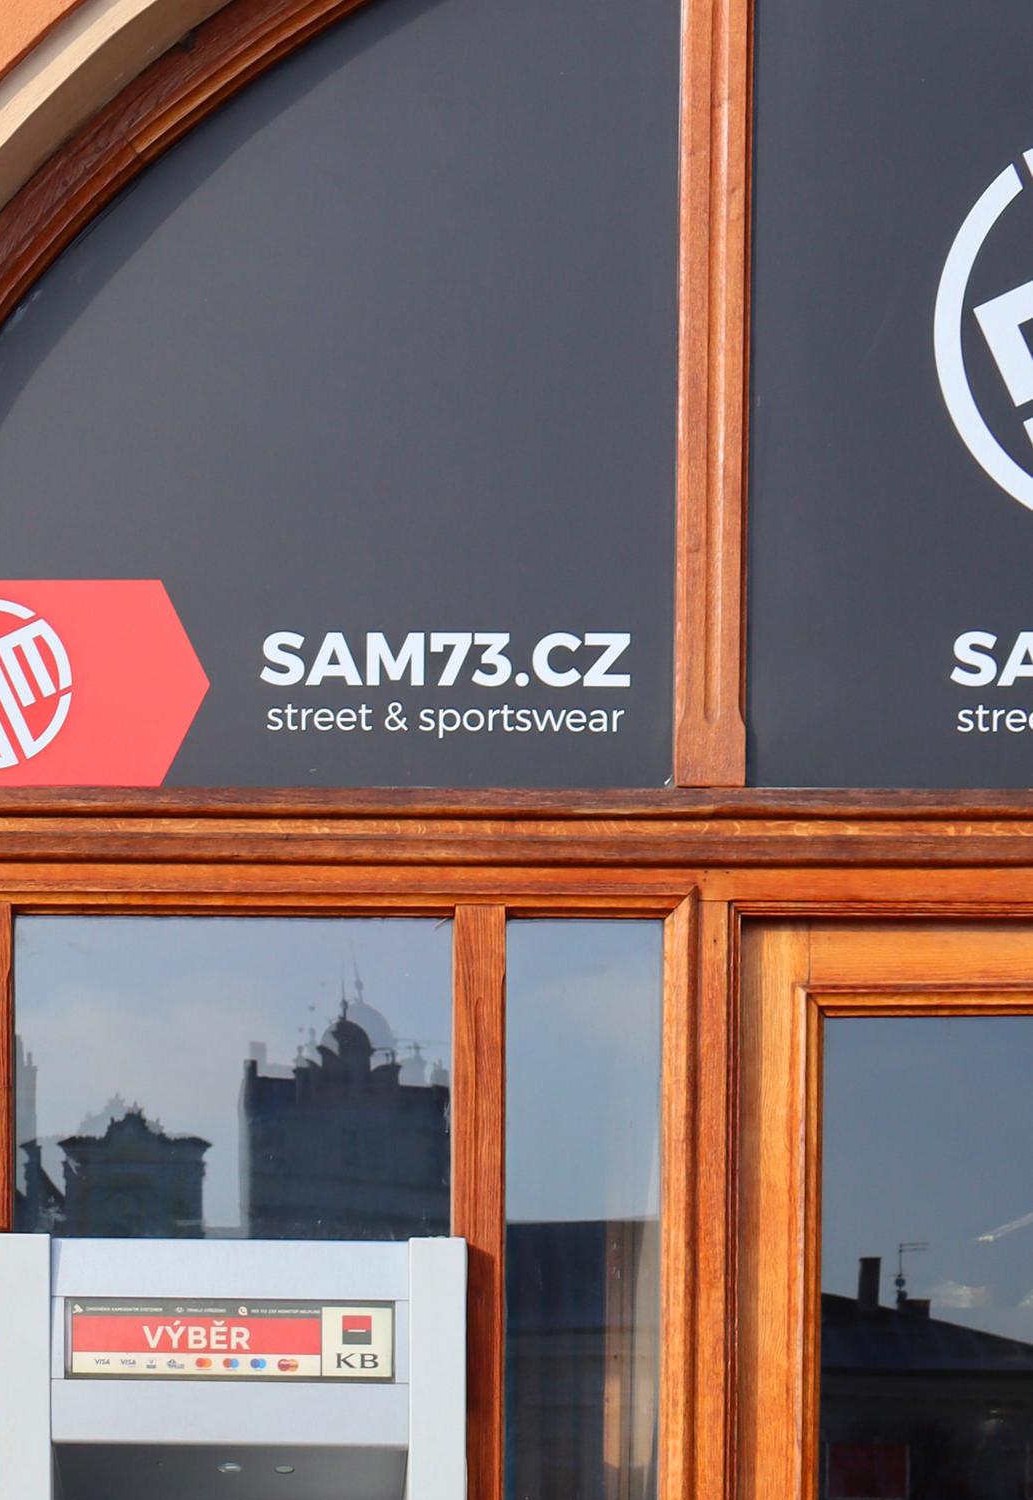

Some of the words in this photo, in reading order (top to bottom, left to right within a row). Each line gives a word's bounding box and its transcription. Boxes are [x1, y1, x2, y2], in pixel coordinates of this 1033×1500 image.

[260, 631, 632, 688] SAM73.CZ
[266, 703, 372, 733] street
[383, 703, 409, 733] &
[418, 703, 626, 739] sportswear
[957, 704, 1033, 733] stre
[143, 1319, 250, 1350] VÝBĚR
[336, 1353, 379, 1369] KB
